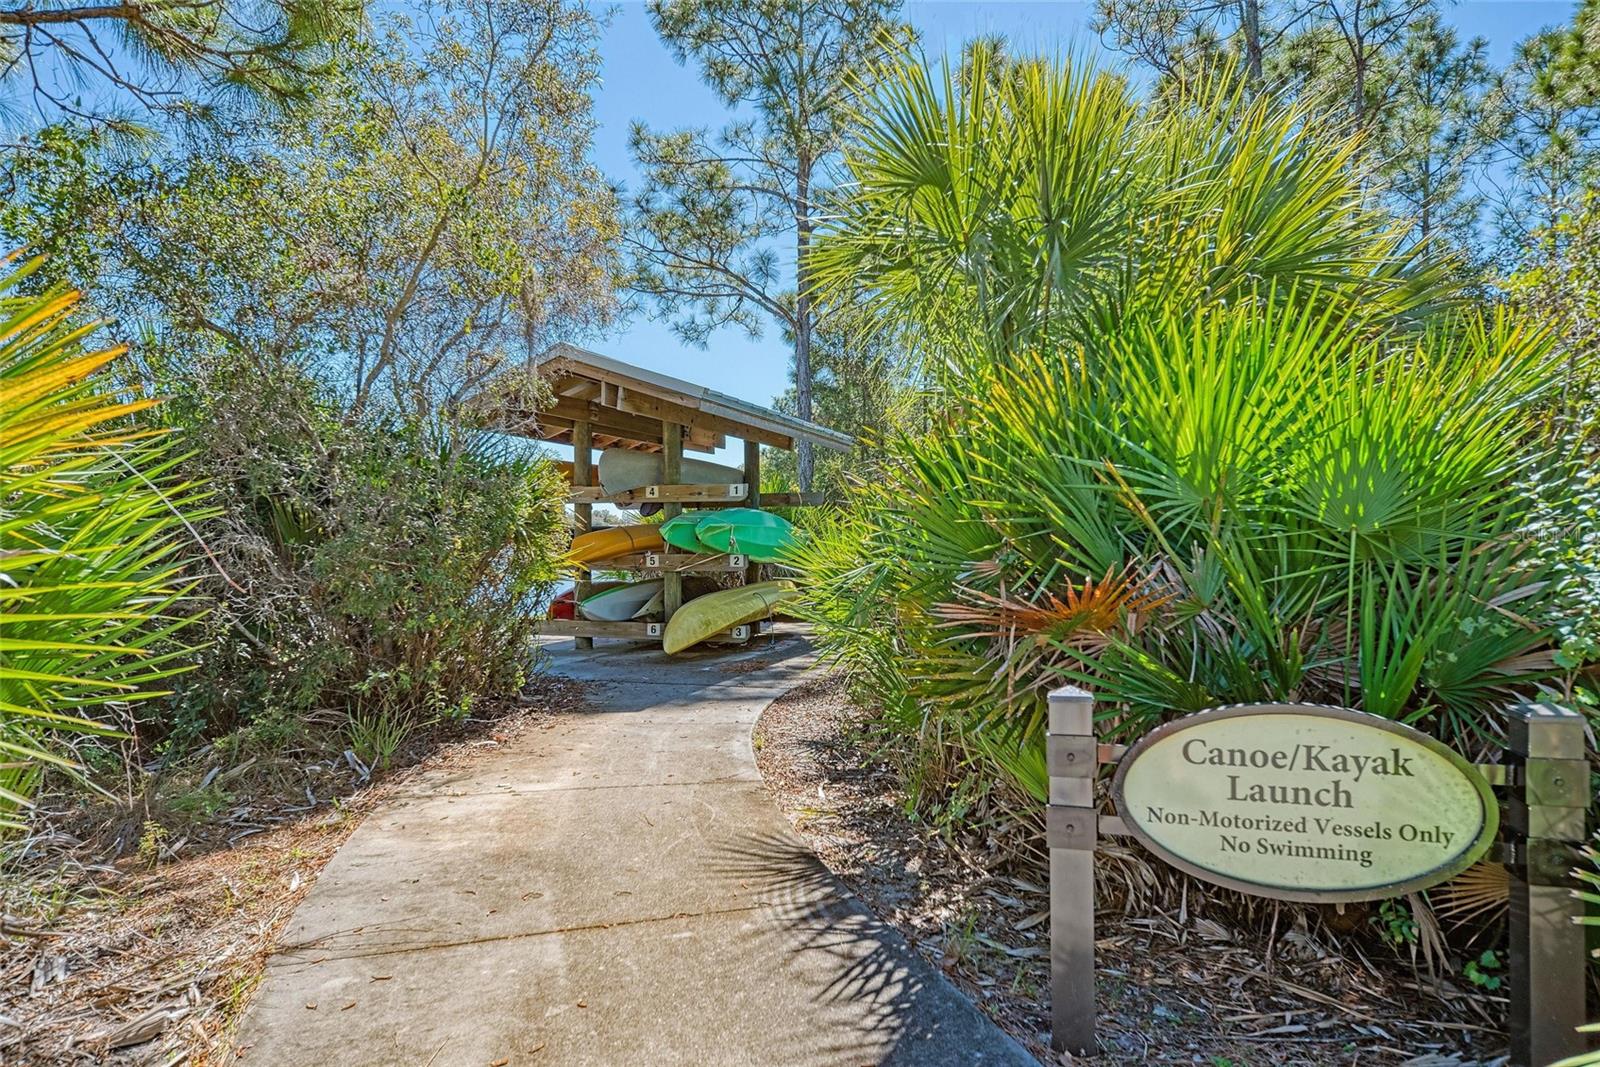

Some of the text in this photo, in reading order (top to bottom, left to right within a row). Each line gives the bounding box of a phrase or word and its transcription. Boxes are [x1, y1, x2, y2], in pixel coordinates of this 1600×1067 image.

[649, 487, 655, 496] 4
[734, 486, 739, 495] 1
[649, 556, 656, 566] 5
[733, 556, 740, 565] 2
[650, 624, 657, 634] 6
[735, 627, 742, 637] 3
[1182, 738, 1415, 782] Canoe/Kayak
[1227, 775, 1355, 809] Launch
[1146, 806, 1456, 849] Non-Motorized Vessels Only
[1219, 835, 1374, 868] No Swimming
